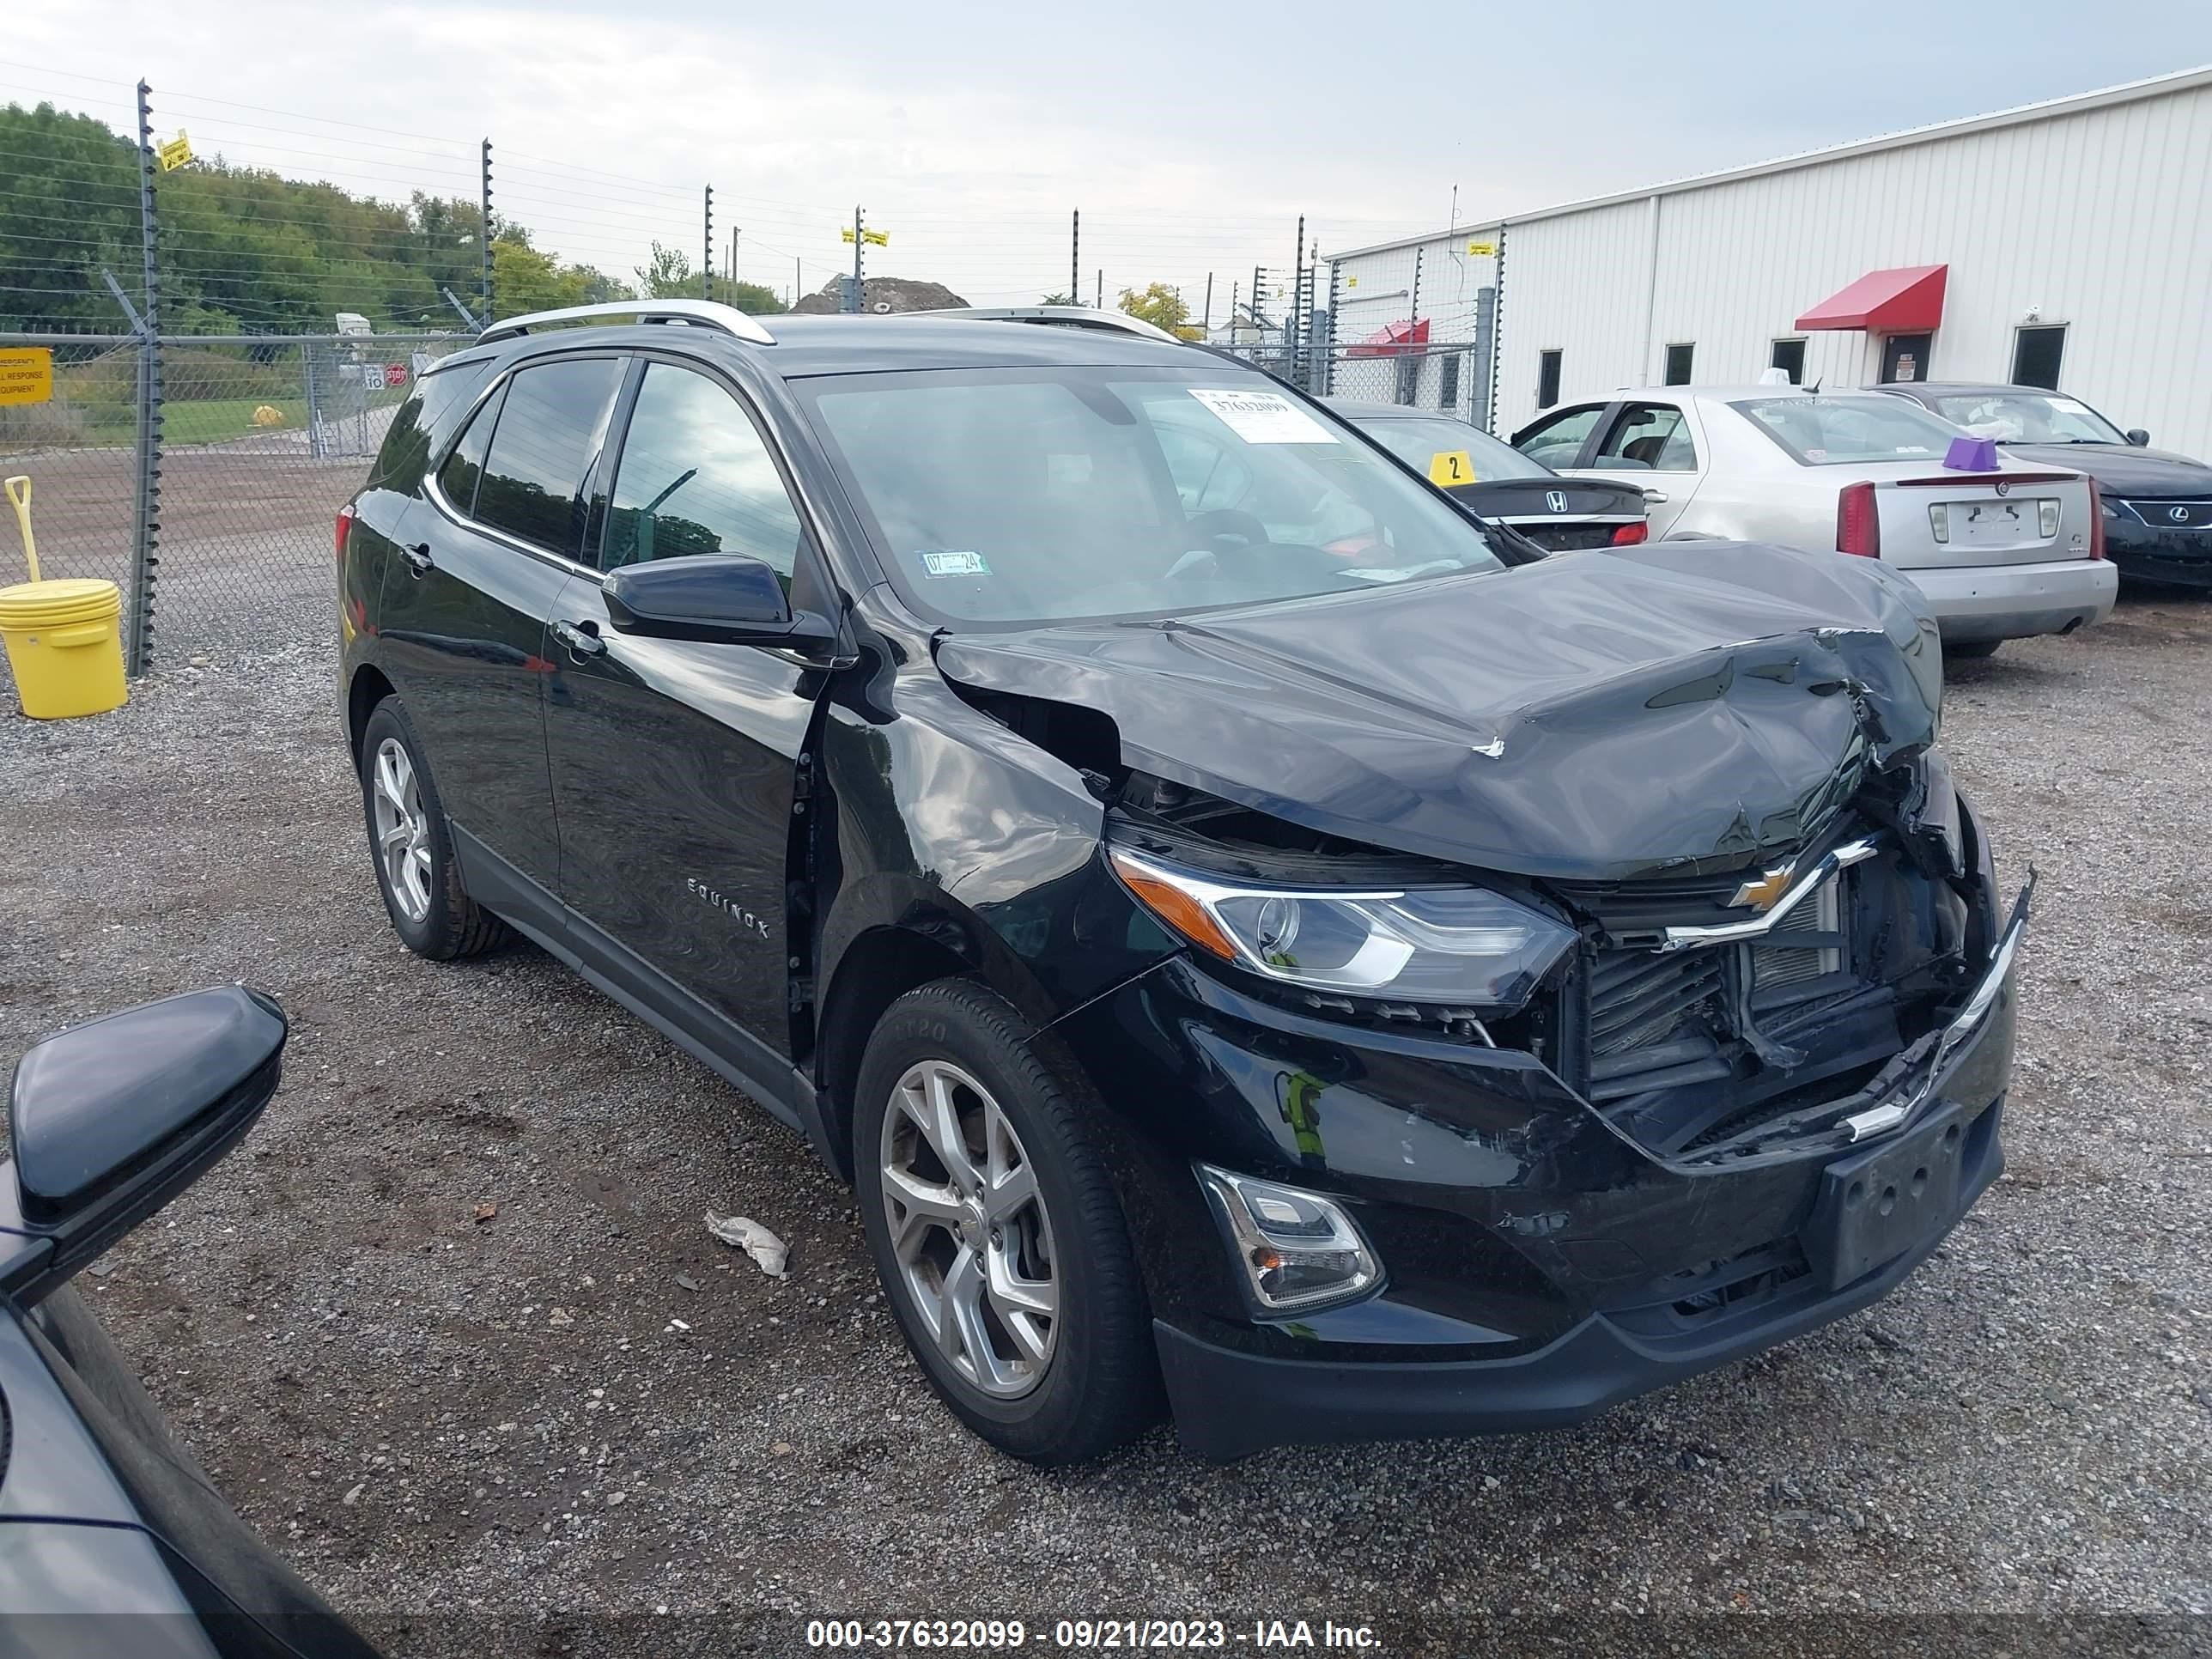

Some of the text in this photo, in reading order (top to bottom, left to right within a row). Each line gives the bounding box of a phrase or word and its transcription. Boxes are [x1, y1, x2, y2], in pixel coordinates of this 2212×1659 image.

[7, 370, 44, 380] RESPONSE
[386, 370, 406, 379] STOP
[368, 378, 382, 388] 10
[0, 384, 35, 394] QUIPMENT
[1212, 400, 1289, 412] 37632099
[1449, 456, 1462, 480] 2
[927, 555, 942, 571] 07
[687, 877, 770, 939] EQUINOX
